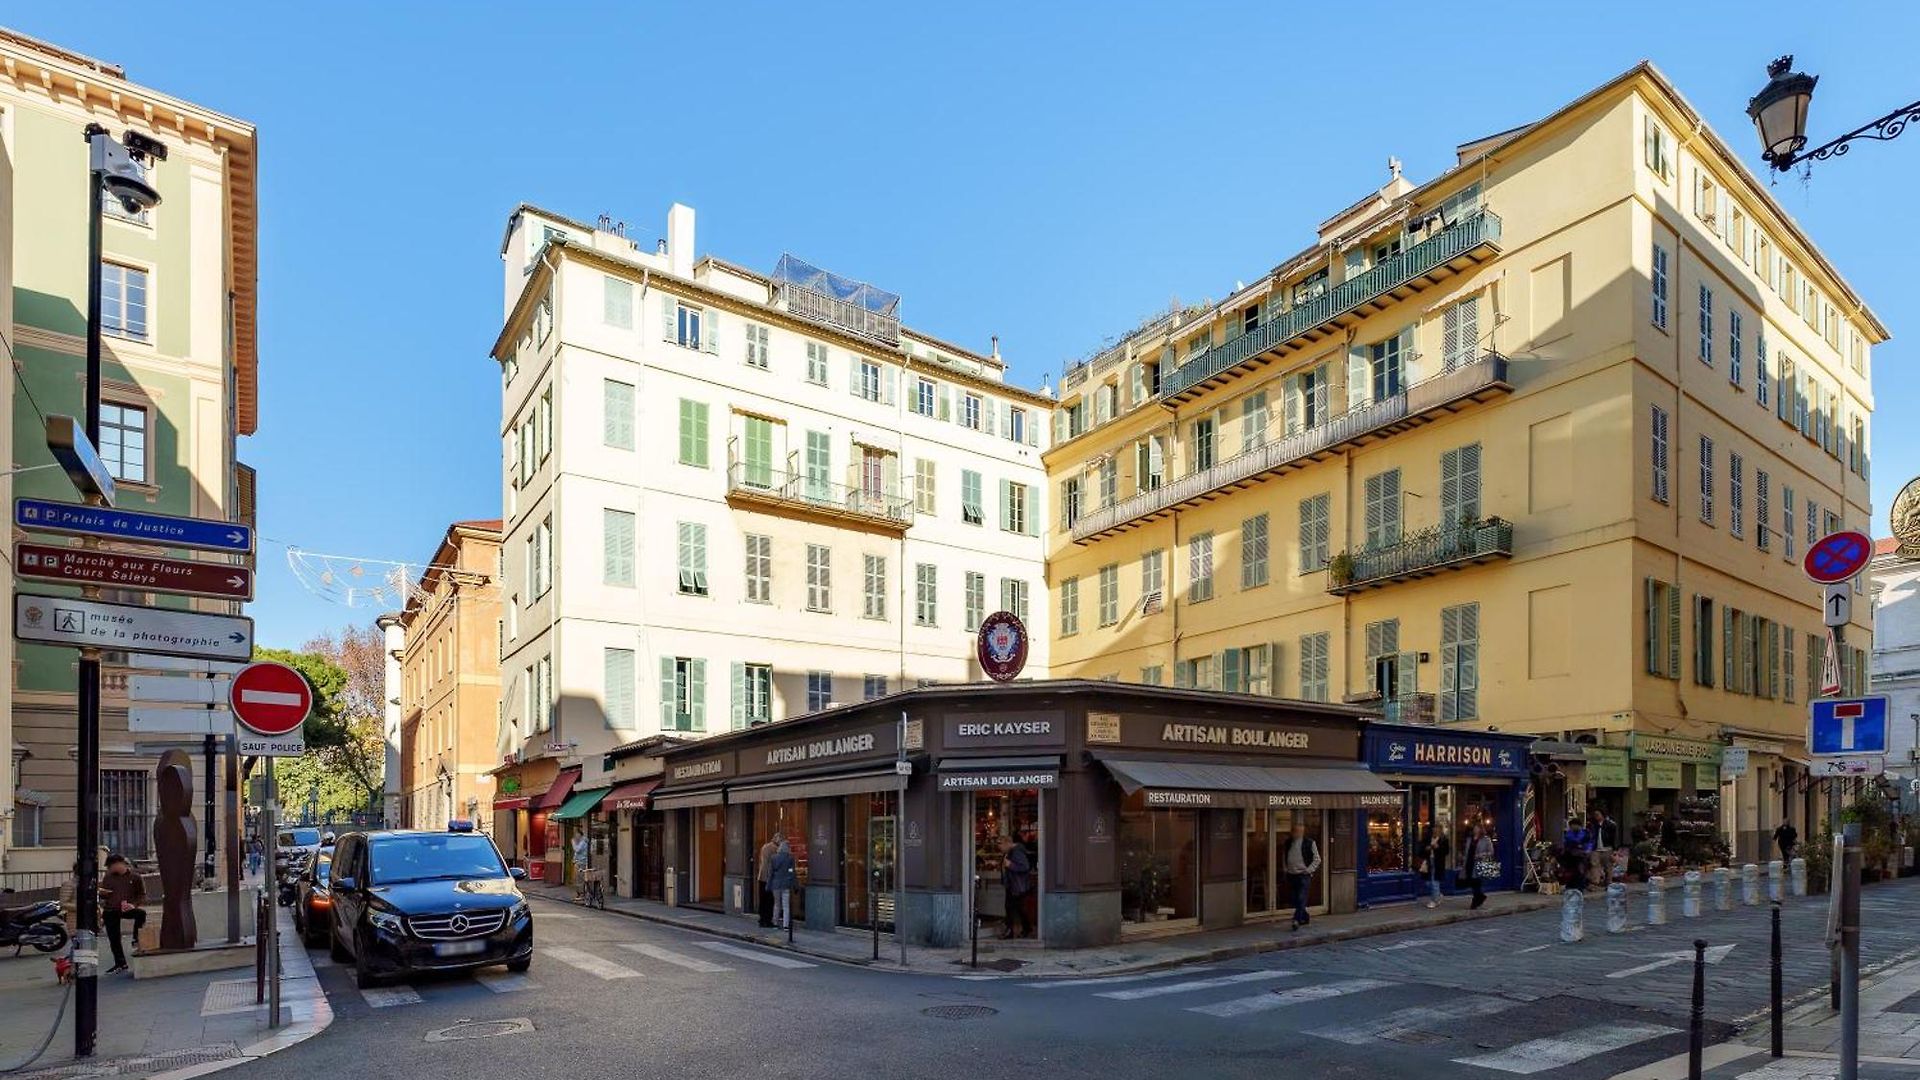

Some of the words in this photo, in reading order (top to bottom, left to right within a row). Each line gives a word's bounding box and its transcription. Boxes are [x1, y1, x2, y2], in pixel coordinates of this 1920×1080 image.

[63, 512, 105, 526] Palais
[113, 519, 128, 528] de
[136, 521, 184, 535] Justice
[64, 553, 114, 568] Marché
[122, 562, 145, 571] aux
[152, 563, 193, 576] Fleurs
[64, 565, 103, 578] Cours
[111, 570, 156, 583] Saleya
[90, 613, 134, 624] musée
[91, 627, 106, 636] de
[114, 630, 125, 638] la
[133, 631, 220, 647] photographie
[958, 723, 991, 736] ERIC
[994, 721, 1050, 735] KAYSER
[1162, 723, 1227, 744] ARTISAN
[1231, 727, 1309, 749] BOULANGER
[242, 742, 267, 751] SAUF
[271, 743, 303, 752] POLICE
[767, 746, 806, 765] ARTISAN
[809, 734, 874, 759] BOULANGER
[1415, 743, 1491, 764] HARRISON
[674, 759, 722, 779] RESTAURATION
[943, 776, 987, 787] ARTISAN
[991, 774, 1053, 786] BOULANGER
[1148, 792, 1211, 805] RESTAURATION
[1269, 795, 1285, 805] ERIC
[1286, 795, 1312, 805] KAYSER
